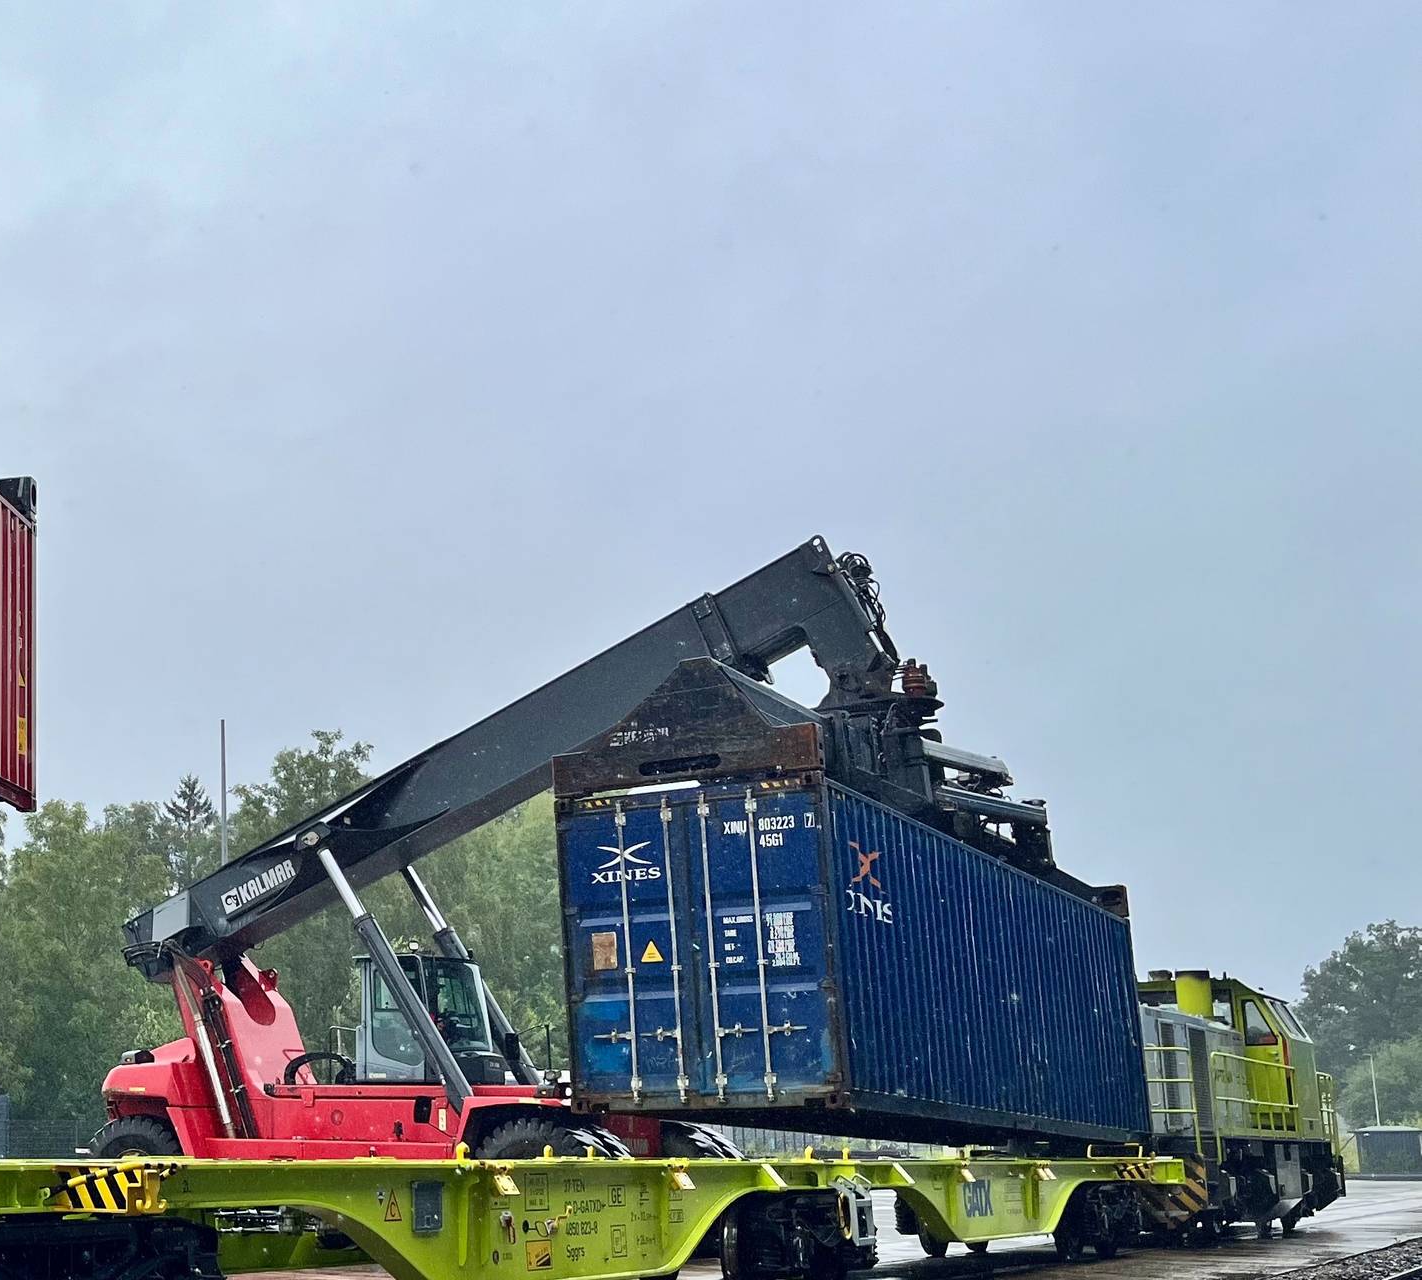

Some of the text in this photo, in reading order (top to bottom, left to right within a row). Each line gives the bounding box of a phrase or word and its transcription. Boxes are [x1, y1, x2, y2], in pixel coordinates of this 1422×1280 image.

[758, 815, 795, 831] 803223
[759, 832, 784, 848] 45G1
[238, 859, 296, 904] KALMAR
[591, 867, 661, 884] XINES
[611, 1187, 622, 1205] GE
[963, 1179, 994, 1217] GATX
[389, 1202, 396, 1217] C
